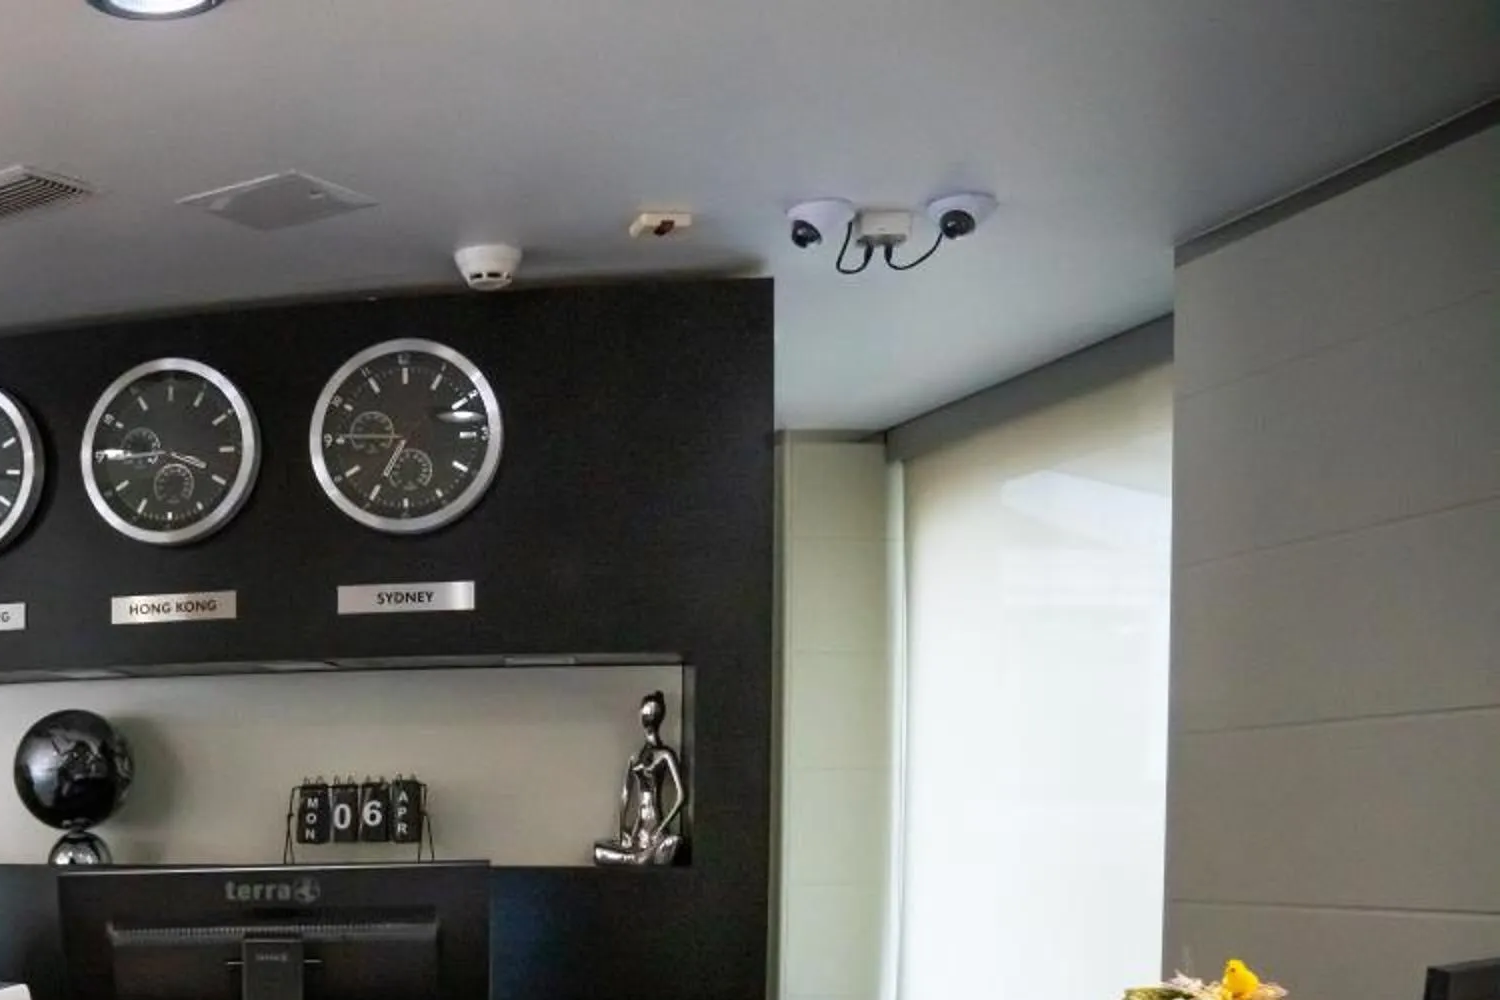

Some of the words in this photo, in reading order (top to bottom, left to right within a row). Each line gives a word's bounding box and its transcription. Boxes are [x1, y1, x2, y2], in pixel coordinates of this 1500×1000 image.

[376, 591, 434, 605] SYDNEY
[129, 602, 171, 615] HONG
[175, 600, 217, 613] KONG
[305, 798, 319, 840] MON
[333, 801, 382, 829] 06
[397, 791, 408, 835] APR
[225, 880, 291, 901] terra
